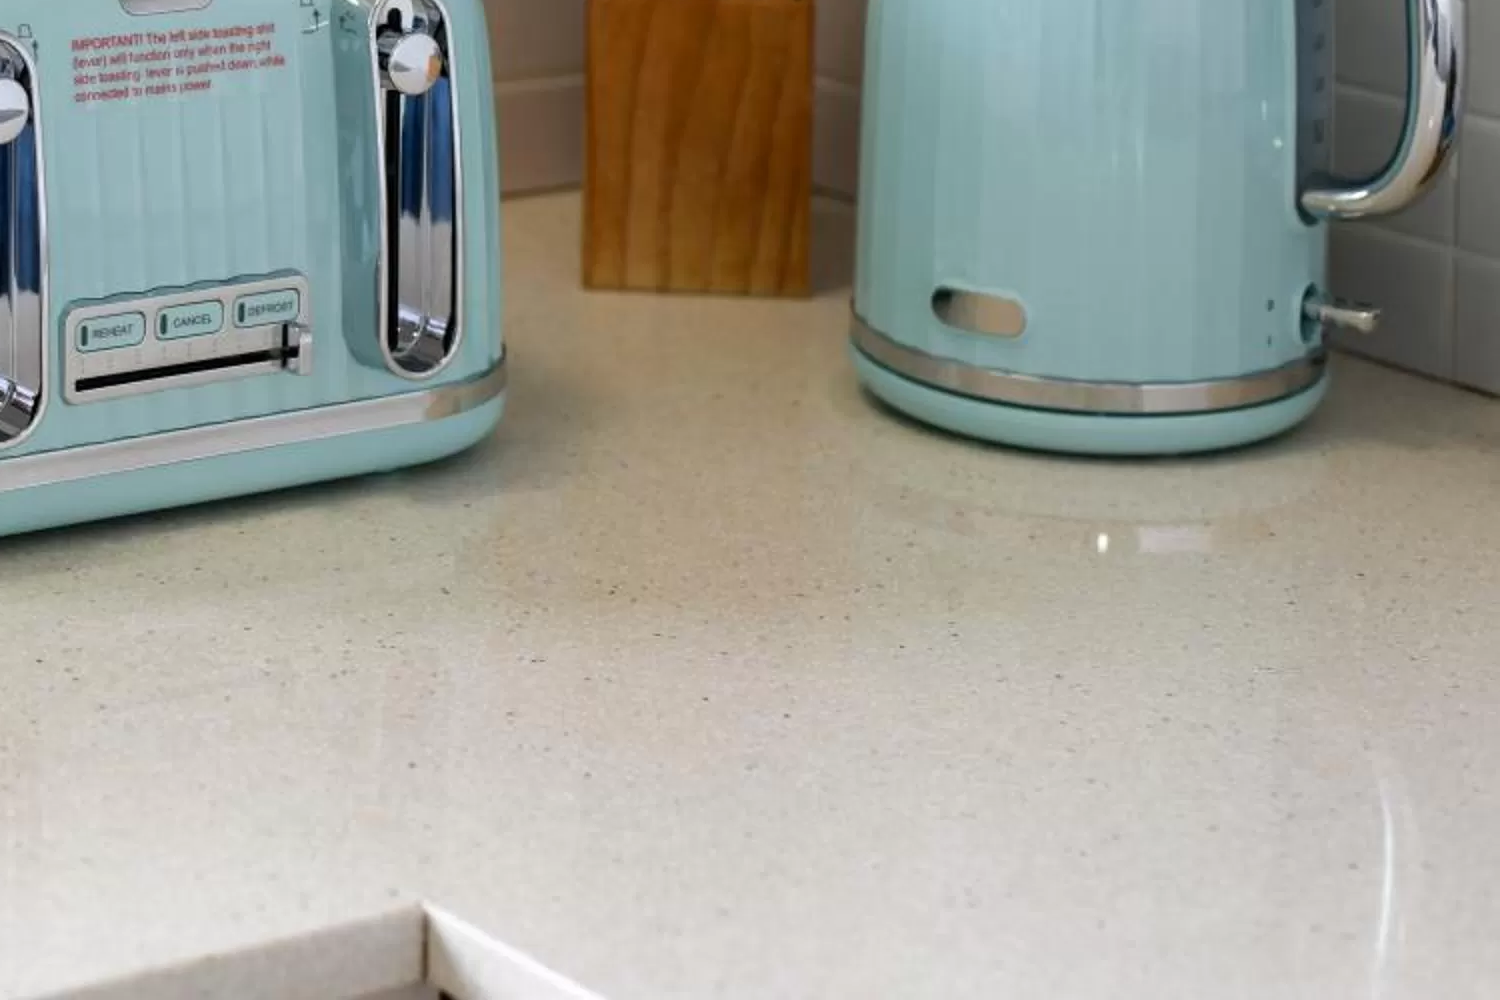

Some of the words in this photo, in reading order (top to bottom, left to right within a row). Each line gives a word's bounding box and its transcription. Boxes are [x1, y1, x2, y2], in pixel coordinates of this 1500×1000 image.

[169, 28, 185, 43] left
[188, 29, 210, 40] side
[212, 25, 253, 39] toasting
[110, 52, 127, 64] will
[129, 50, 169, 63] function
[174, 46, 194, 60] only
[198, 44, 226, 56] when
[230, 42, 245, 53] the
[248, 39, 271, 56] right
[74, 73, 97, 86] side
[145, 67, 171, 78] lever
[187, 60, 225, 76] pushed
[248, 300, 293, 317] DEFROST
[173, 313, 213, 329] CANCEL
[92, 323, 133, 339] REHEAT
